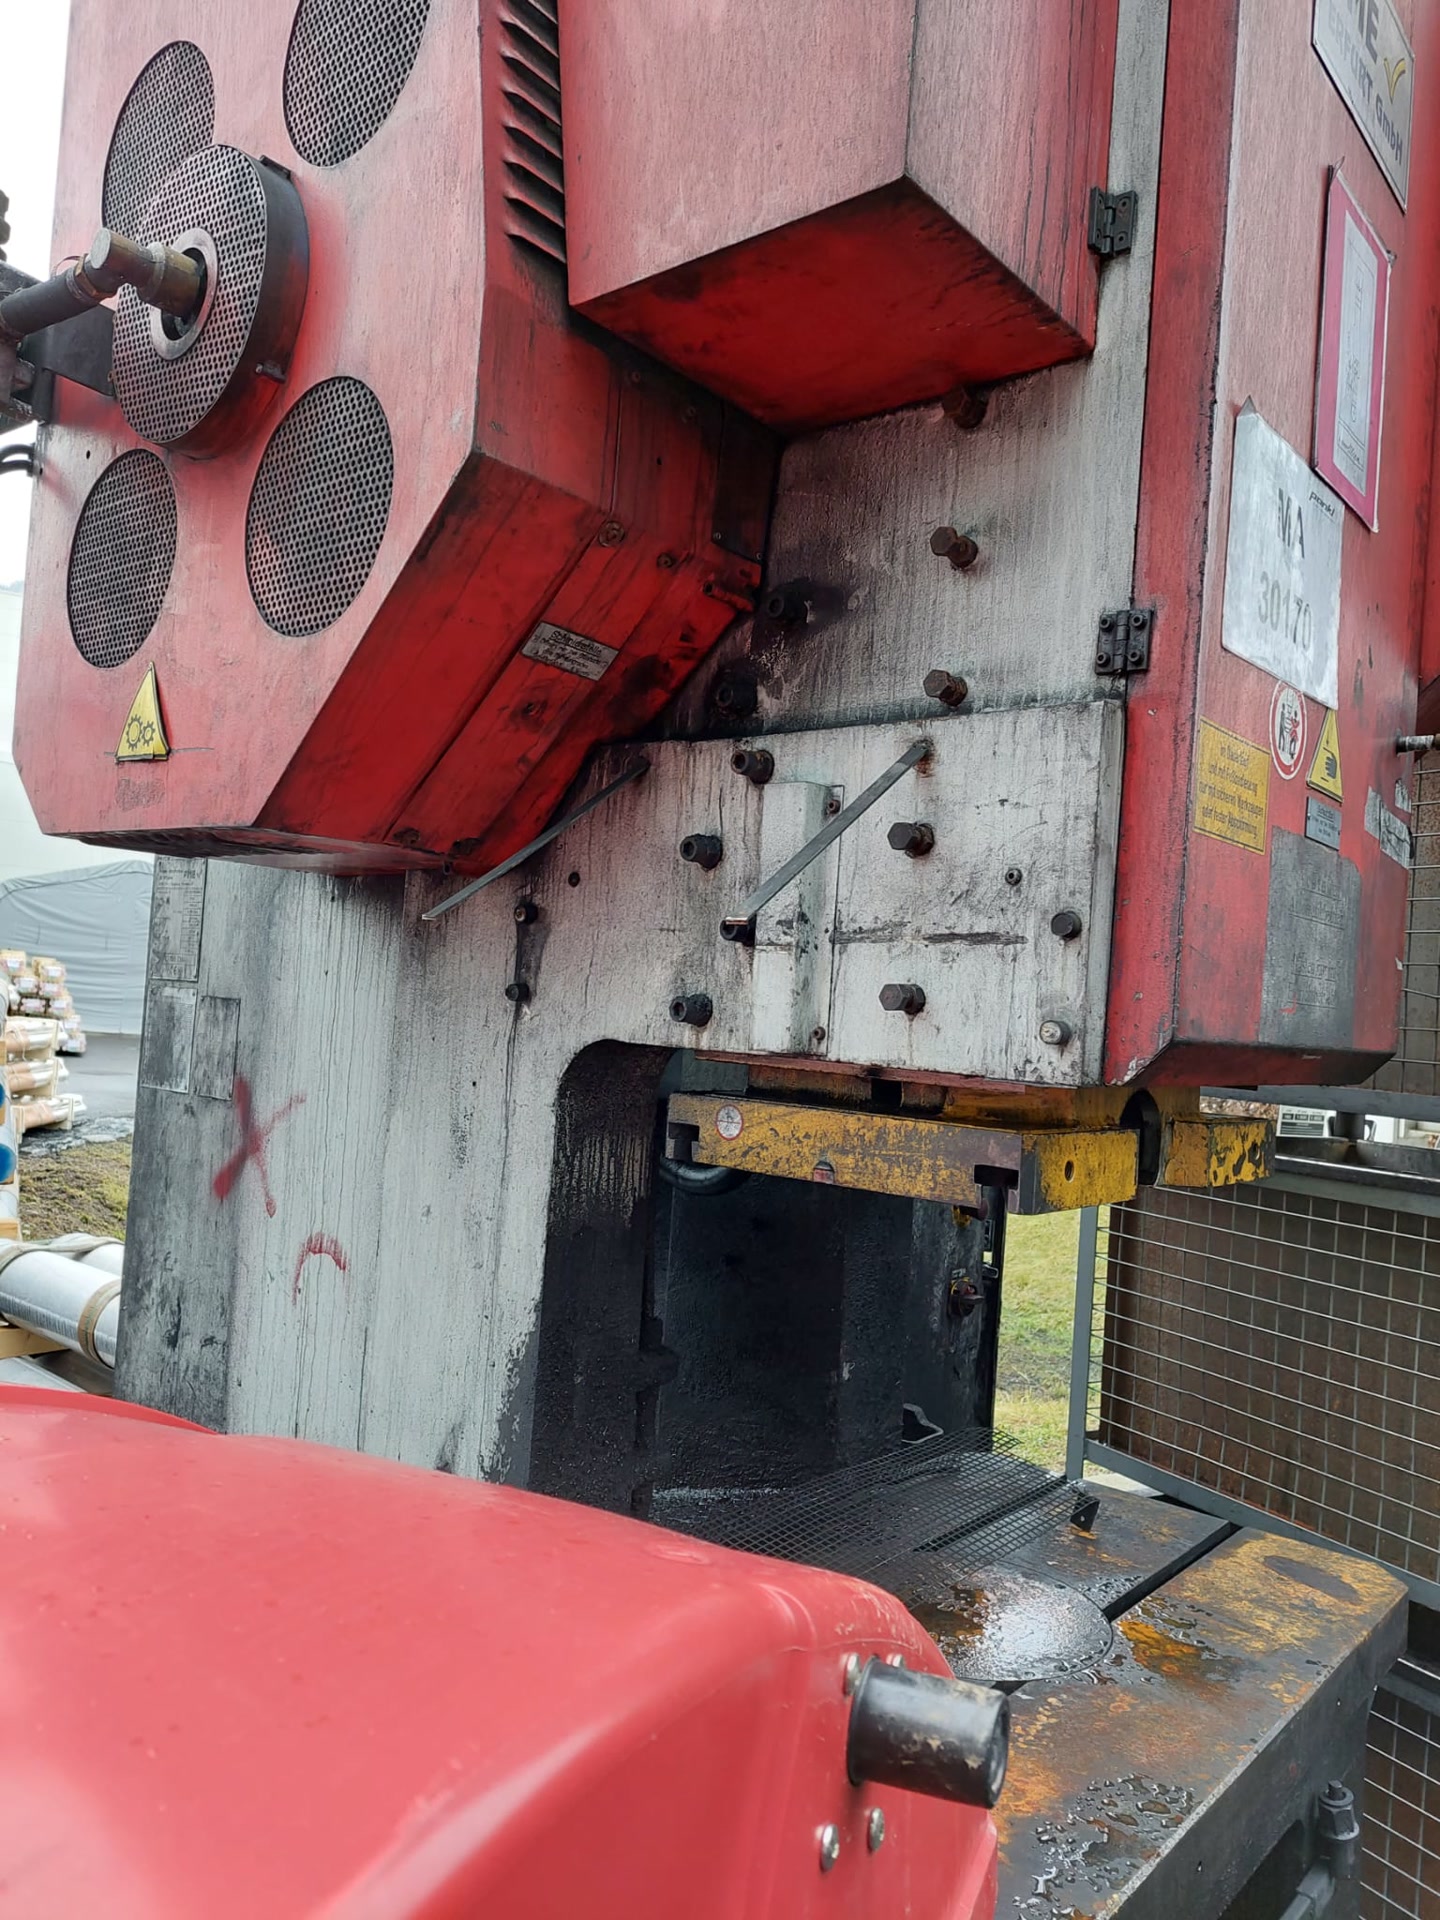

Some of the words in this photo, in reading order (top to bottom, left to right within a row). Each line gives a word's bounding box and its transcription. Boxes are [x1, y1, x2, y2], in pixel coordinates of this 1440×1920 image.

[1329, 1, 1373, 105] ERFURT
[1375, 94, 1403, 166] GmbH
[1278, 487, 1304, 559] MA
[1258, 571, 1311, 650] 30170
